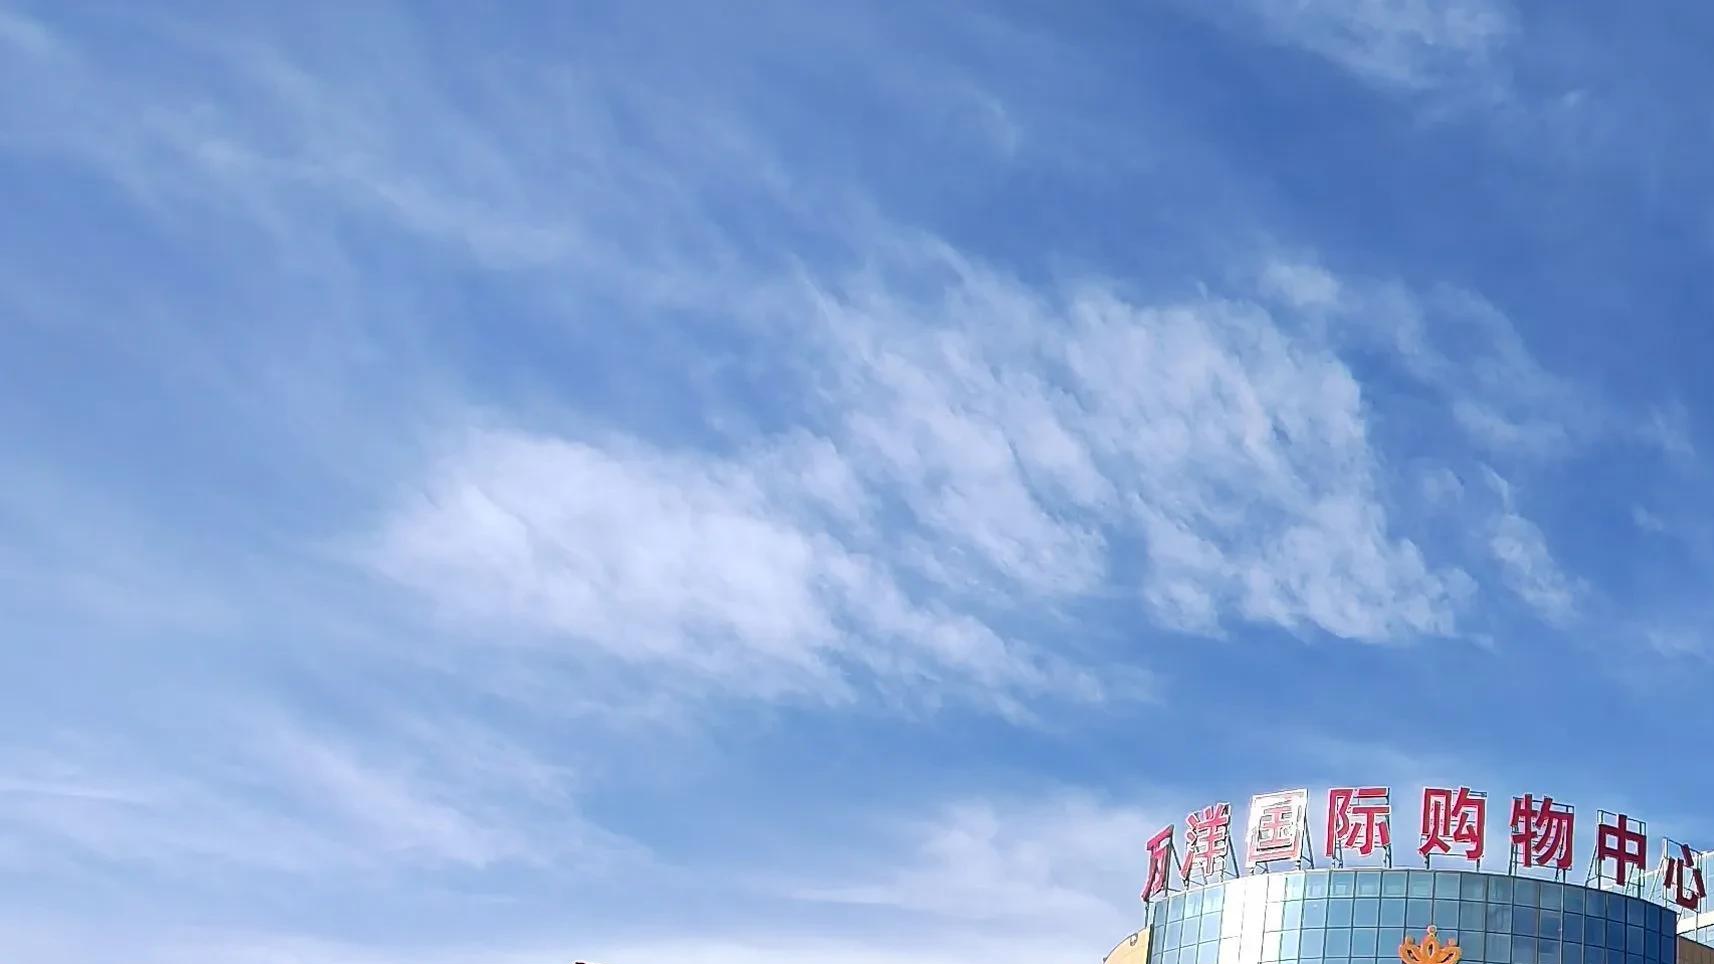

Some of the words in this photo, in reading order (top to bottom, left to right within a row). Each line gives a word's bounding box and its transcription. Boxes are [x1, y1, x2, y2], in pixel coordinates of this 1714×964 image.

[1142, 786, 1706, 909] 万洋国际购物中心
